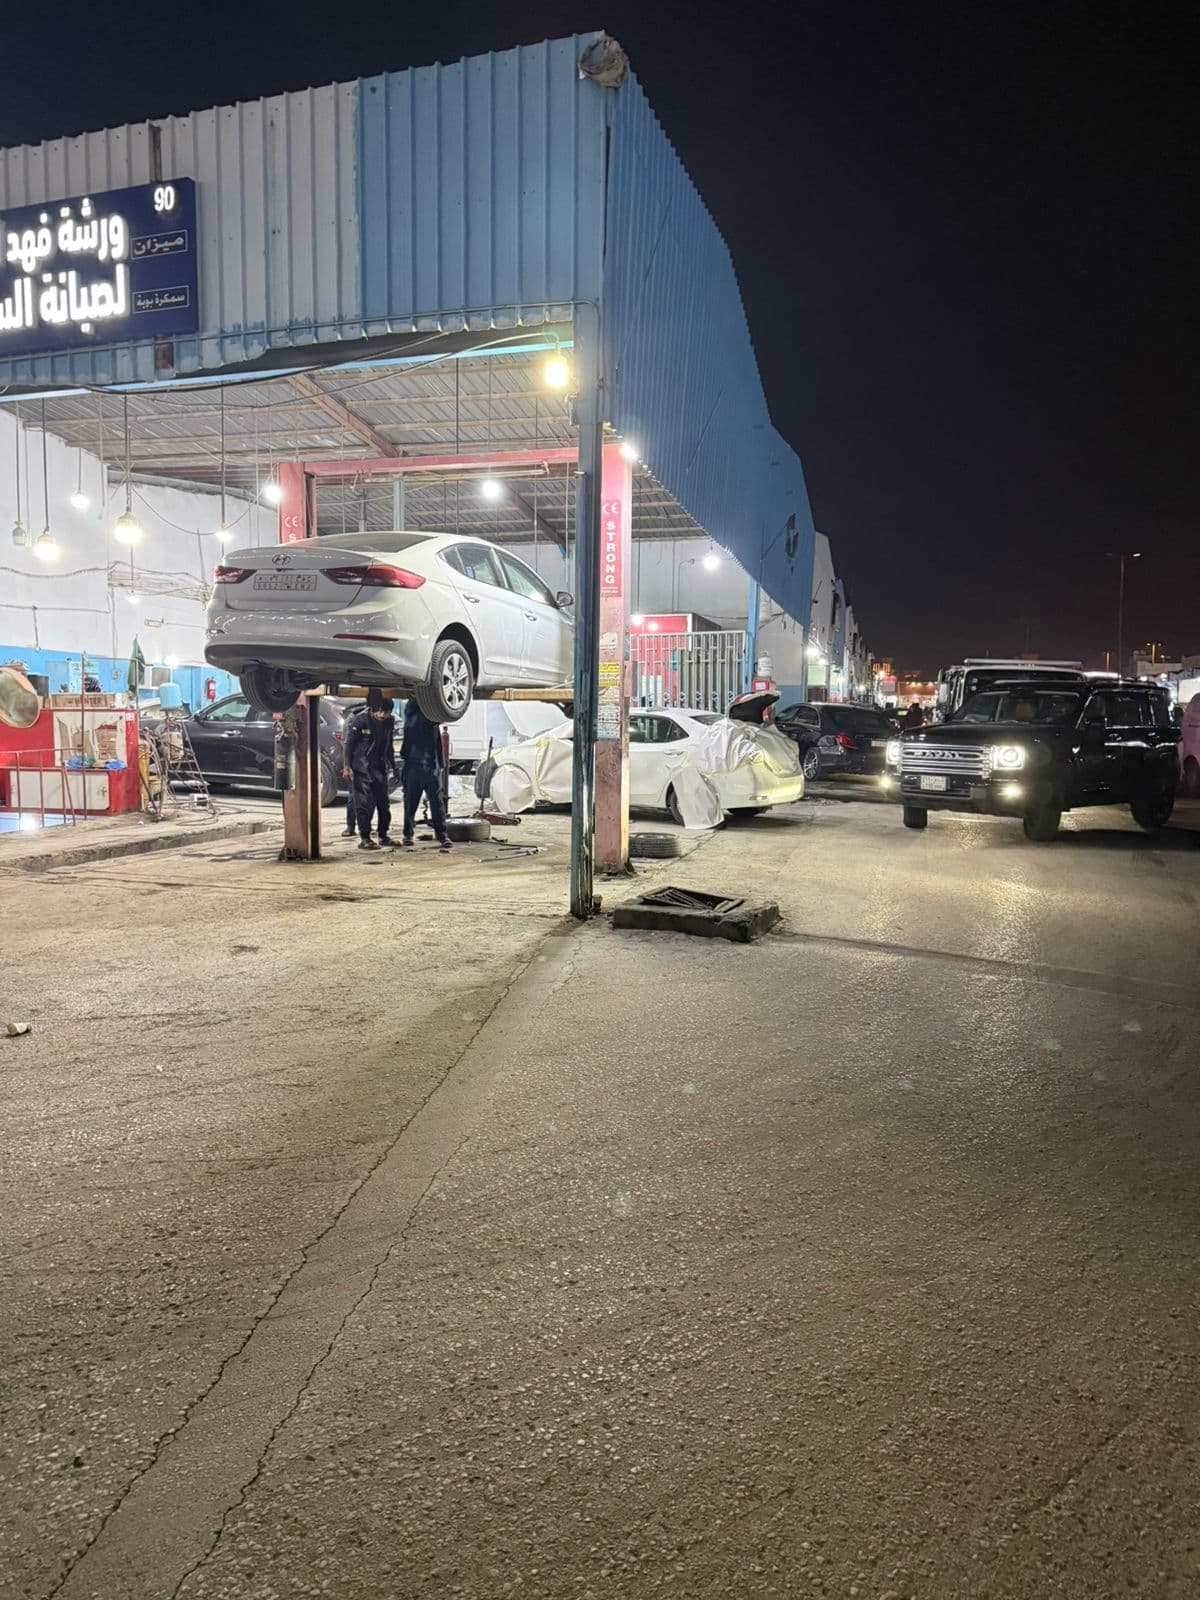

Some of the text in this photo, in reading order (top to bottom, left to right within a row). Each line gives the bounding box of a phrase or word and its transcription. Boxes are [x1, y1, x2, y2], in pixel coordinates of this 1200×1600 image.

[154, 186, 175, 212] 90
[6, 197, 124, 272] ورشة فهد
[134, 236, 184, 255] ميزان
[0, 263, 125, 333] لصيانة الس
[155, 293, 185, 306] سمكرة
[602, 502, 618, 514] CE
[285, 515, 298, 528] CE
[606, 521, 616, 584] STRONG
